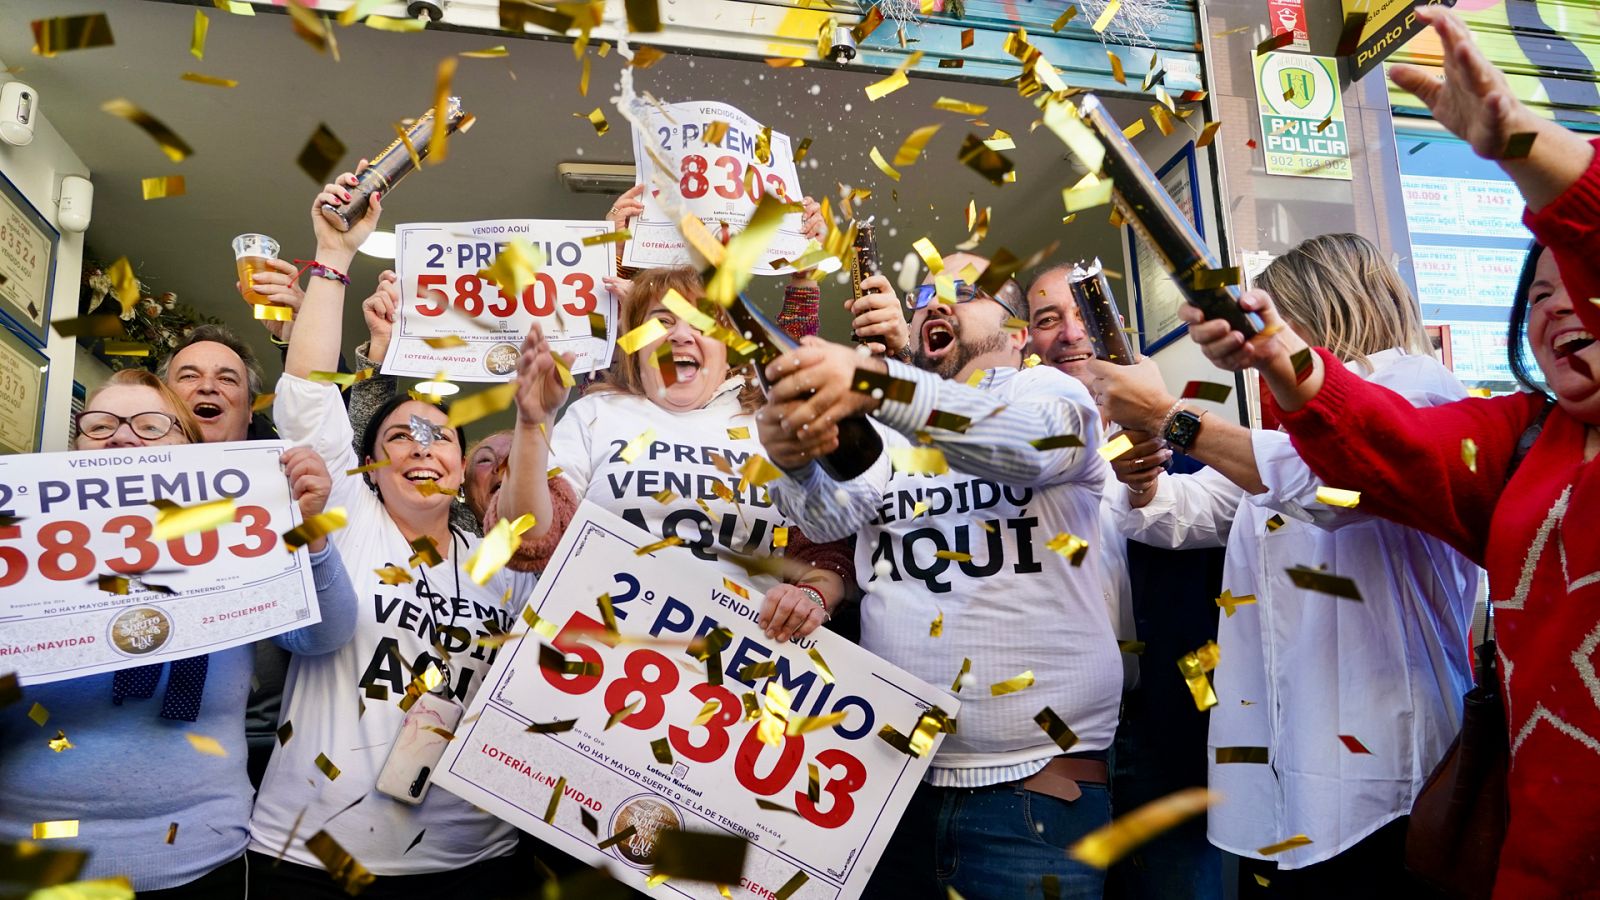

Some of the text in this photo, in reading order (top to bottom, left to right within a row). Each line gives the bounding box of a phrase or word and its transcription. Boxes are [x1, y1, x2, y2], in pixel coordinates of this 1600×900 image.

[1357, 26, 1402, 68] Punto
[700, 107, 735, 119] VENDIDO
[1271, 118, 1338, 138] AVISO
[682, 124, 775, 168] PEM
[1267, 135, 1347, 155] POLICIA
[1271, 155, 1348, 170] 902 184 902
[652, 154, 793, 207] 8303
[472, 224, 530, 235] VENDIDO AQUÍ
[426, 241, 582, 269] 2º PRIO
[415, 272, 598, 319] 58303
[68, 452, 172, 468] VENDIDO AQUÍ
[649, 440, 751, 469] PREM
[38, 468, 251, 514] PREMIO
[607, 470, 780, 512] VENDID
[870, 477, 1034, 526] ENDIDO
[868, 508, 1043, 594] AQUÍ
[44, 607, 57, 615] NO
[59, 604, 77, 613] HAY
[79, 600, 110, 611] MAYOR
[111, 596, 142, 607] SUERTE
[143, 593, 160, 602] QUE
[186, 585, 226, 596] TENERNOS
[202, 600, 278, 625] 22 DICIEMBRE
[374, 594, 499, 666] VENDI
[711, 588, 819, 650] VENDI QUÍ
[358, 637, 487, 704] AQU
[539, 610, 868, 830] 58303
[545, 776, 603, 812] NVIDAD
[577, 741, 760, 842] NO HAY MAYOR SUERTE QUE LA DE TENERNOS
[645, 764, 704, 798] Lotería Nacional
[755, 822, 782, 839] MALAGA
[738, 876, 777, 900] CIEMB
